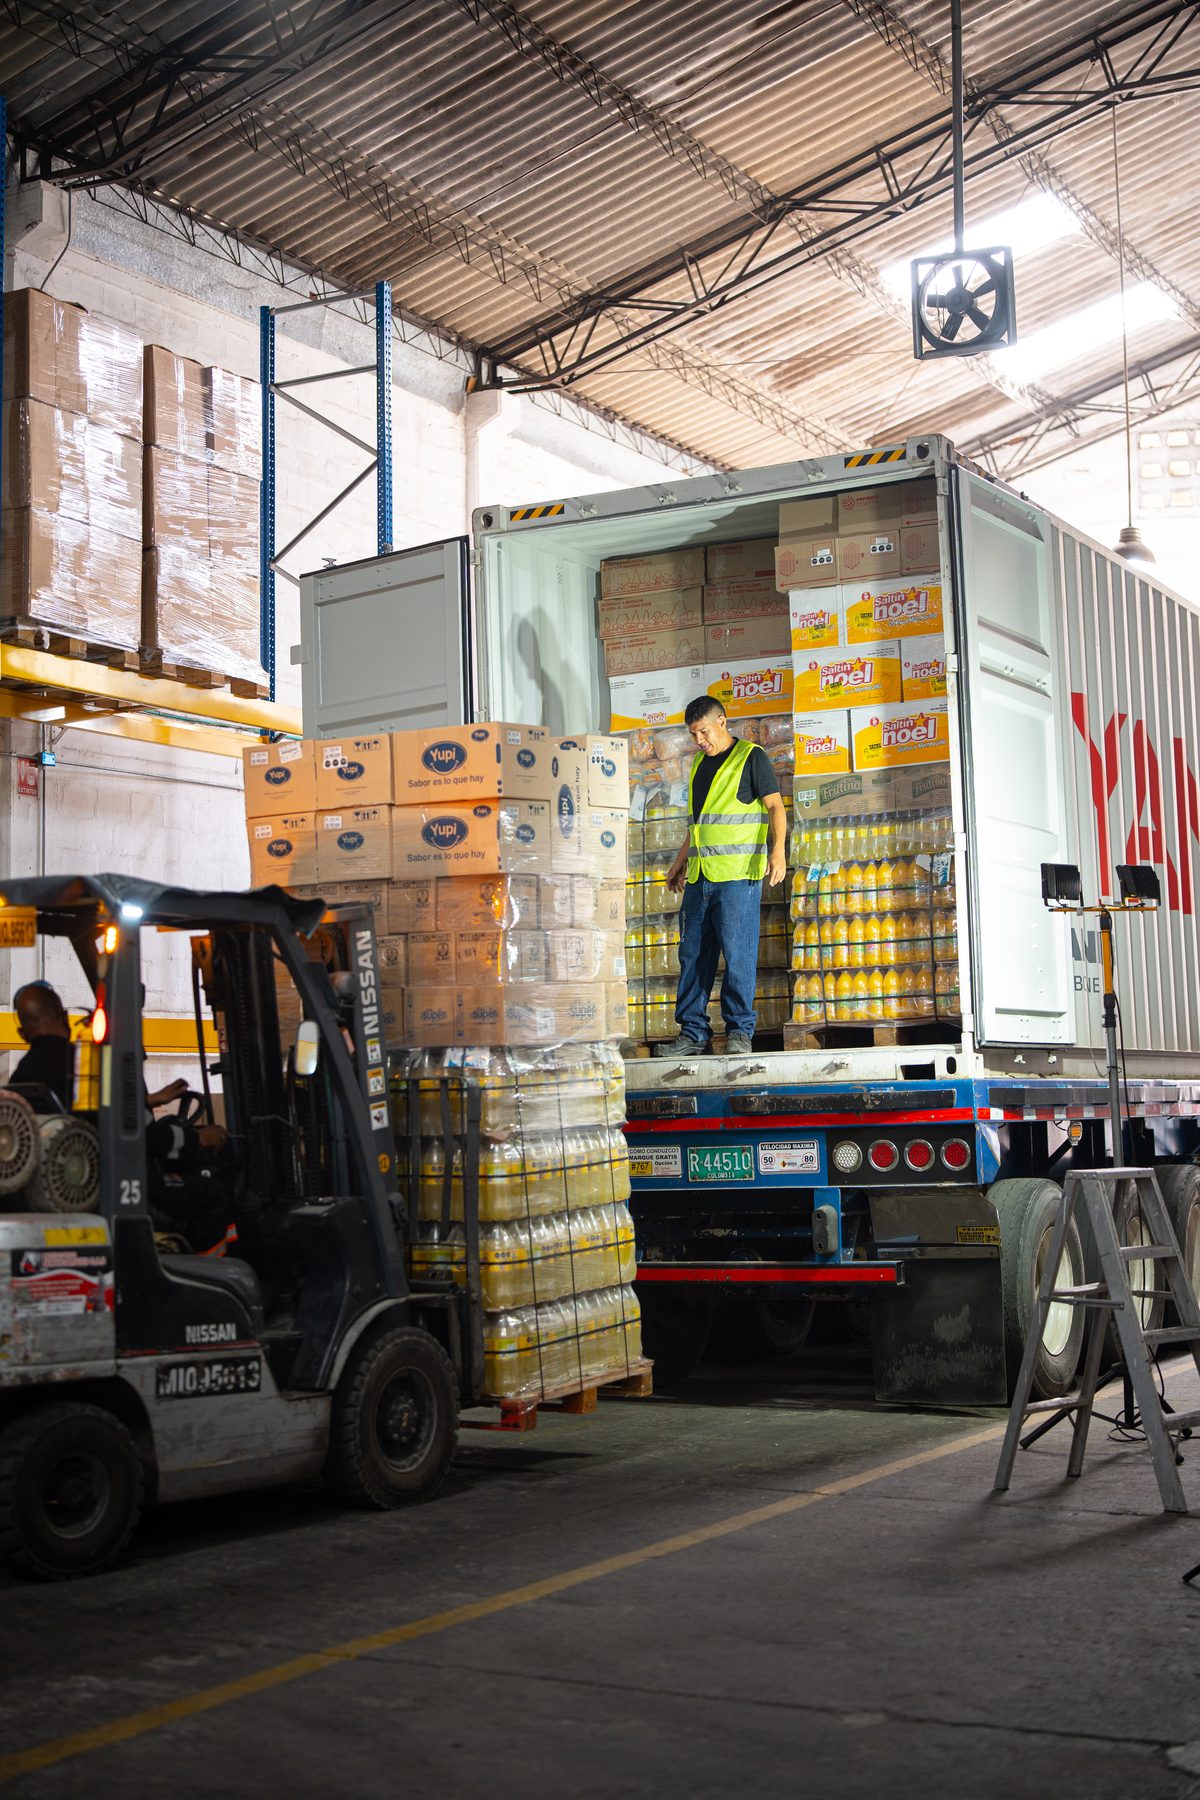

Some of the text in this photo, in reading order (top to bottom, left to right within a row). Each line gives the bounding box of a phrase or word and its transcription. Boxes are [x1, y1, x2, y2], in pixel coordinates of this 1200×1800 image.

[875, 592, 905, 606] Saltin
[875, 592, 927, 620] noel
[800, 612, 829, 628] noel
[821, 662, 872, 690] noel
[822, 663, 850, 676] Saltin
[912, 661, 944, 678] noel
[734, 673, 761, 686] Saltin
[734, 673, 782, 698] noel
[883, 719, 914, 732] Saltin
[883, 719, 936, 746] noel
[806, 737, 837, 754] noel
[430, 747, 456, 763] Yupi
[520, 752, 532, 762] Yupi
[269, 770, 286, 780] Yupi
[342, 764, 359, 775] Yupi
[408, 774, 484, 788] Sabor es lo que hay
[560, 797, 570, 829] Yupi
[430, 823, 457, 838] Yupi
[342, 834, 359, 844] Yupi
[272, 842, 287, 852] Yupi
[407, 850, 486, 863] Sabor es lo que hay
[355, 930, 380, 1035] NISSAN
[631, 1162, 649, 1170] #767
[764, 1156, 773, 1164] 50
[804, 1155, 814, 1163] 80
[120, 1180, 141, 1204] 25
[185, 1323, 237, 1344] NISSAN
